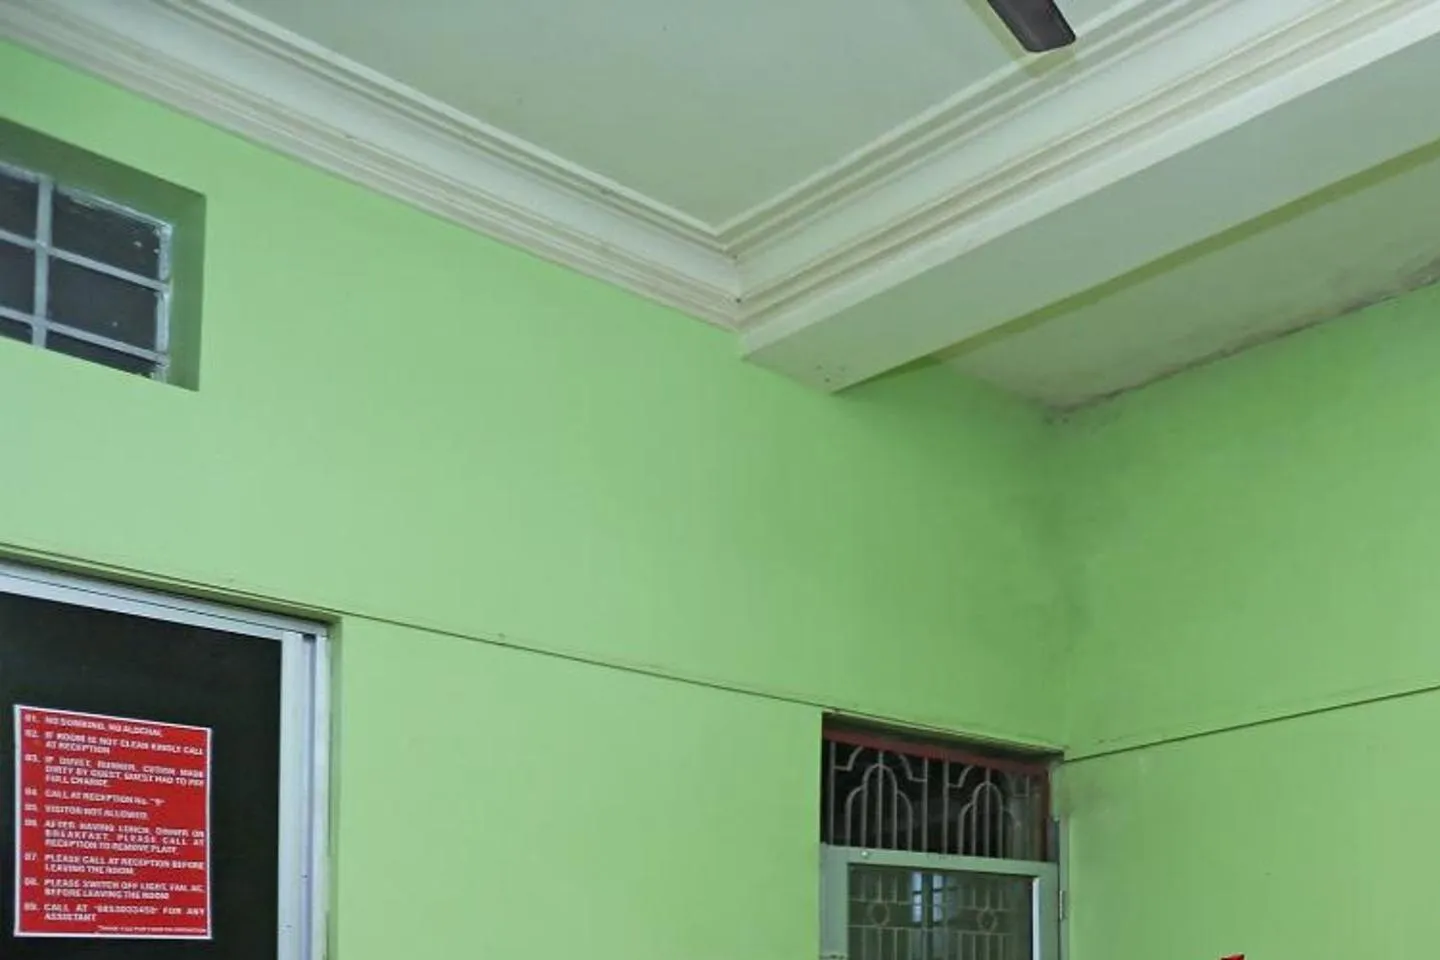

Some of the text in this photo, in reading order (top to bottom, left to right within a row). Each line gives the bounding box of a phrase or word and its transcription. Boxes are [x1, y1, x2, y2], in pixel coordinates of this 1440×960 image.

[162, 836, 187, 845] CALL
[44, 854, 79, 863] PLEASE
[82, 856, 106, 865] CALL
[44, 879, 80, 888] PLEASE
[44, 904, 70, 912] CALL
